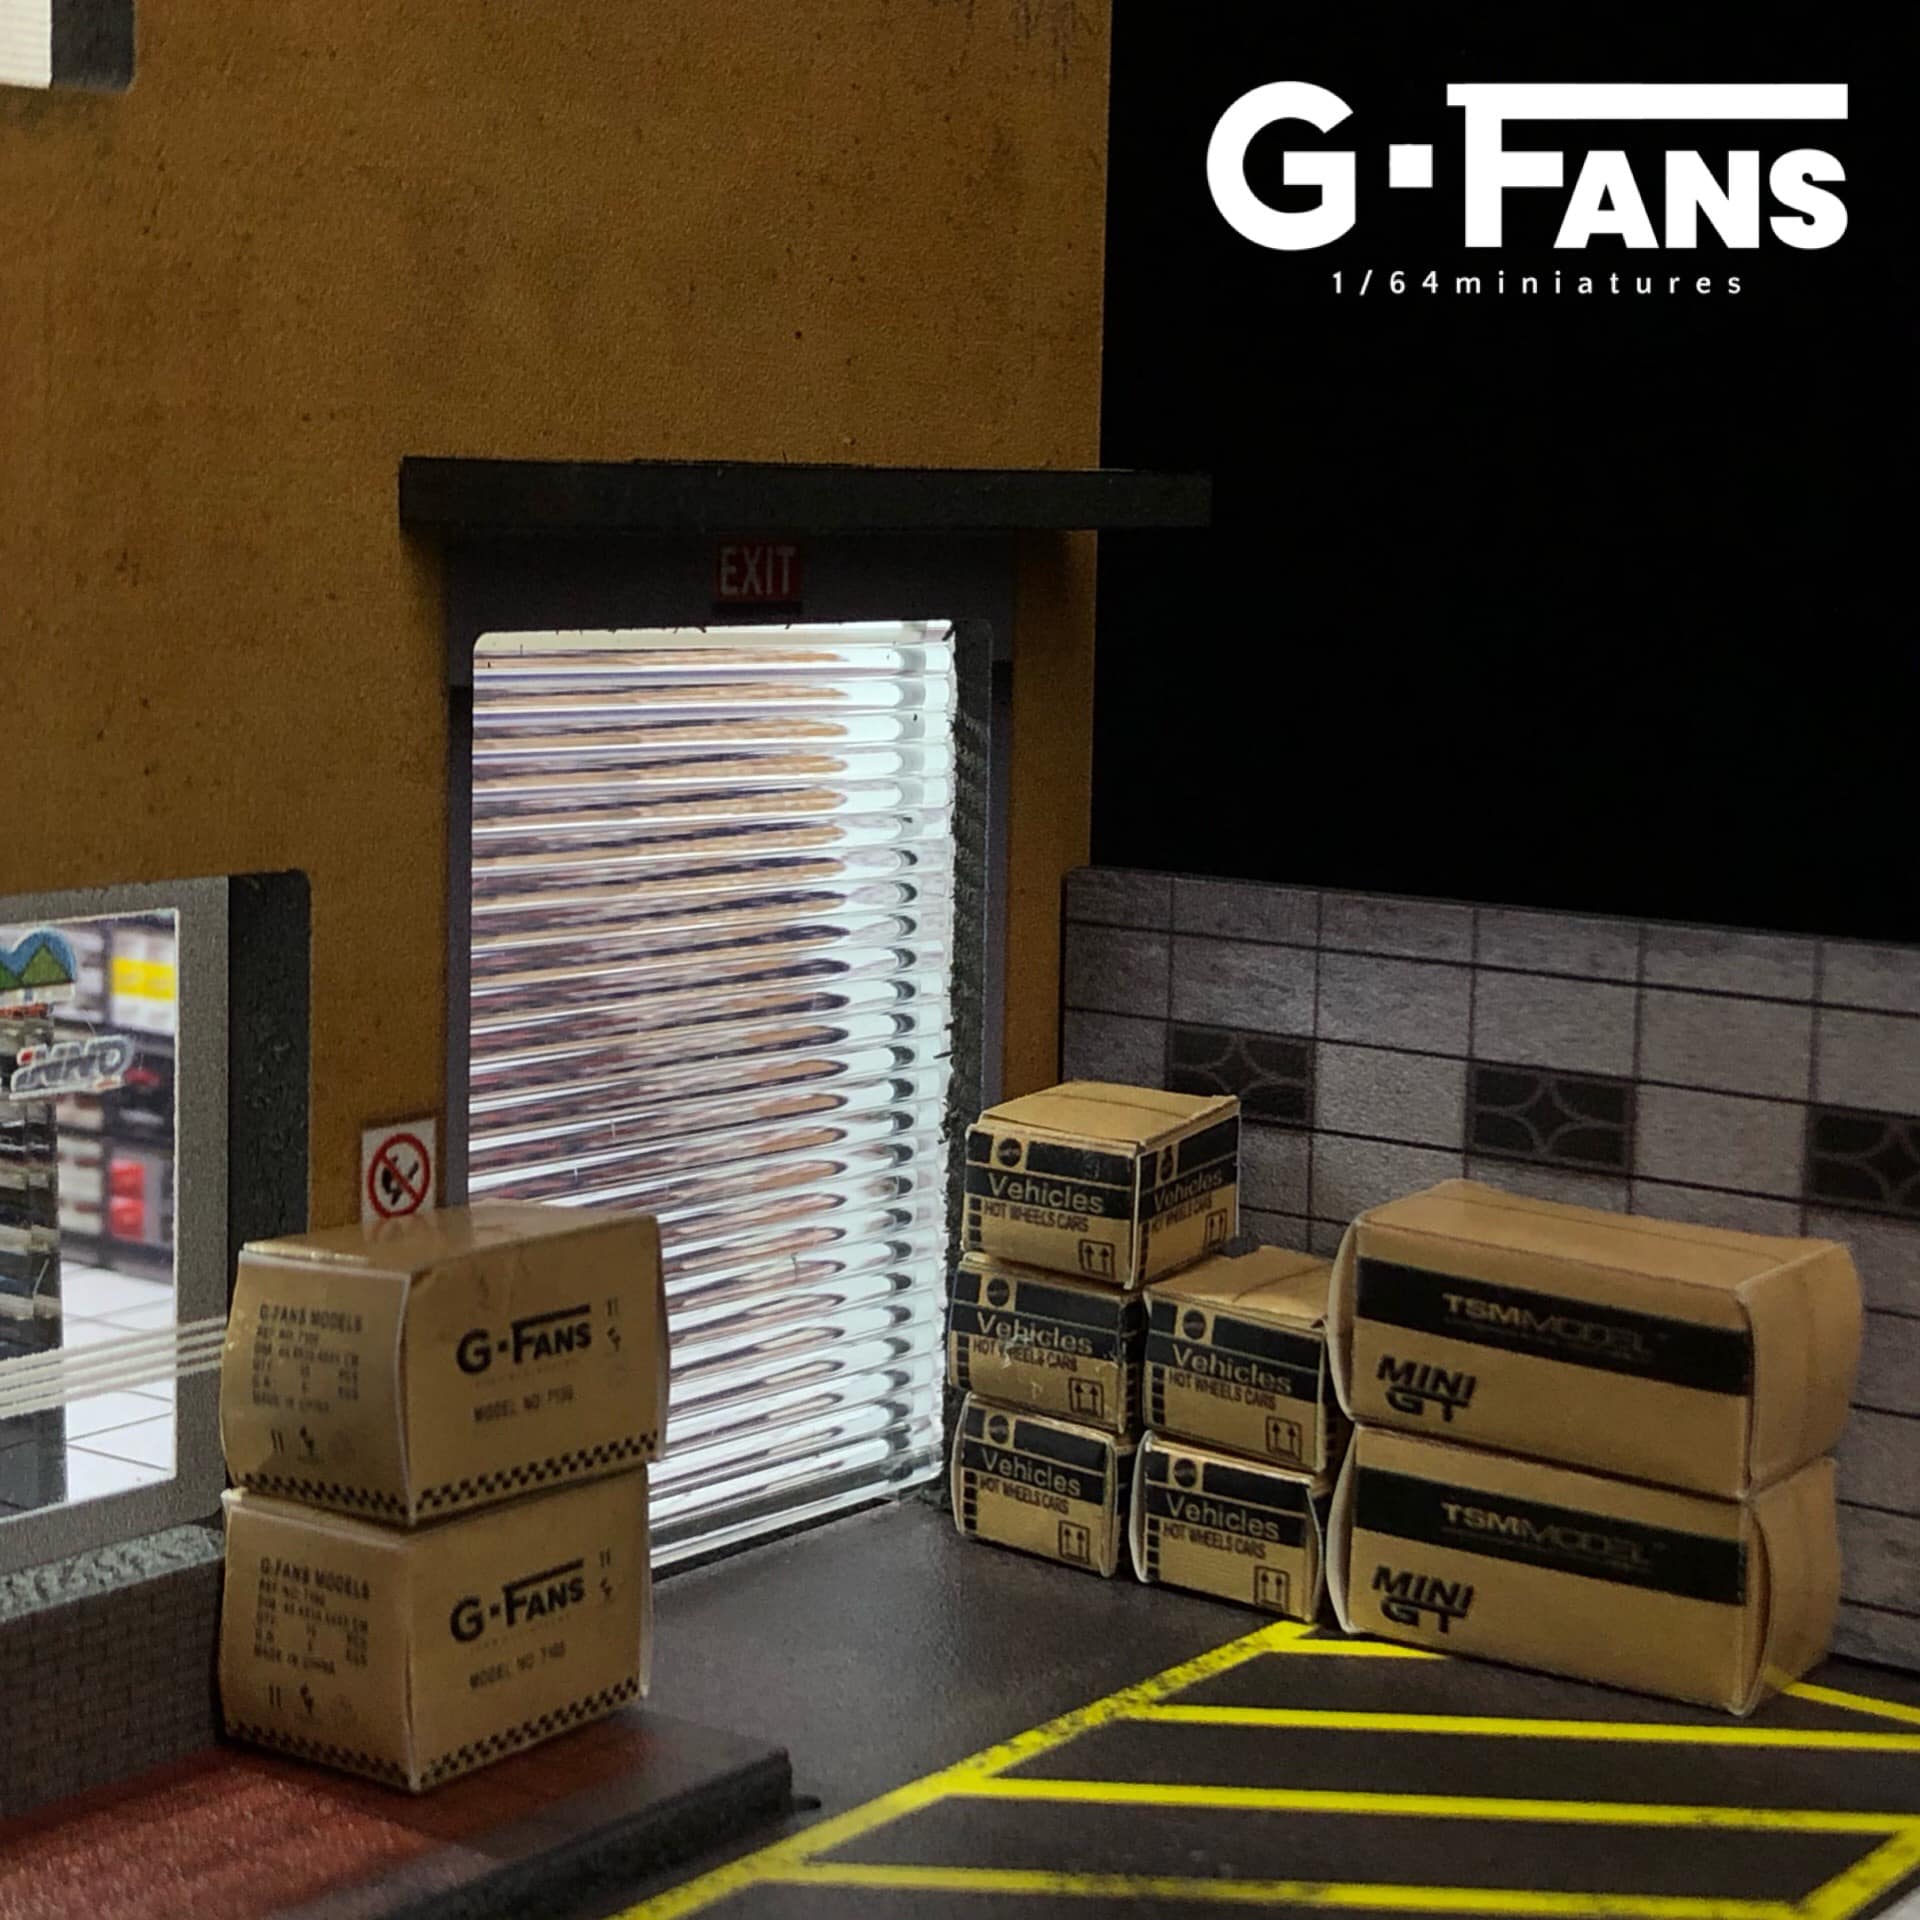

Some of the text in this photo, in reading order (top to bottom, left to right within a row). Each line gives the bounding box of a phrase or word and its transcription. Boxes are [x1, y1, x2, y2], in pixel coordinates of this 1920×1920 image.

[719, 543, 797, 596] EXIT
[988, 1173, 1104, 1214] Vehicles
[1154, 1170, 1222, 1211] Vehicles
[983, 1202, 1089, 1232] HOT WHEELS CARS
[977, 1311, 1093, 1354] Vehicles
[1173, 1343, 1292, 1394] Vehicles
[1377, 1354, 1477, 1401] MINI
[1385, 1384, 1470, 1422] GT
[982, 1447, 1080, 1497] Vehicles
[1165, 1492, 1279, 1540] Vehicles
[1372, 1565, 1474, 1611] MINI
[1381, 1595, 1468, 1634] GT
